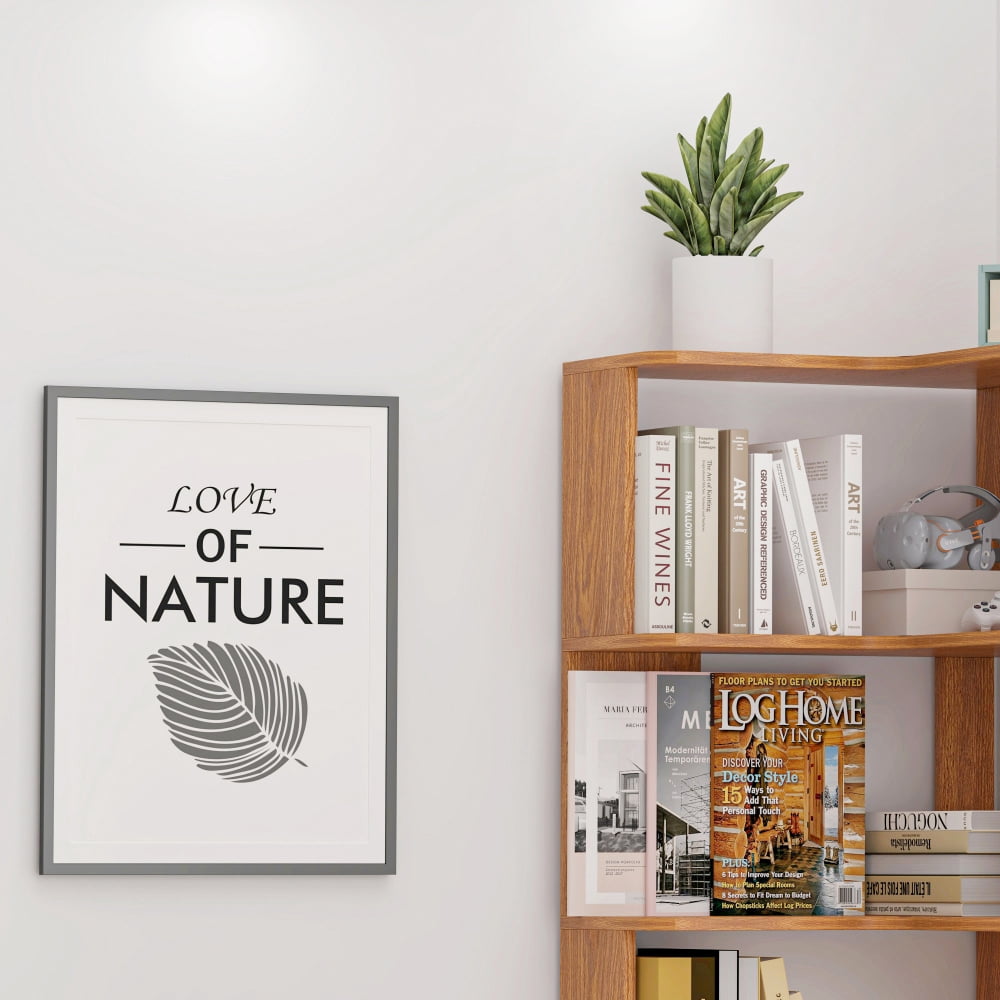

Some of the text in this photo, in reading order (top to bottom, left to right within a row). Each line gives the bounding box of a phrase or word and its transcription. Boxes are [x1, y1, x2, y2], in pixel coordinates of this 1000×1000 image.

[655, 463, 671, 515] FINE
[733, 477, 747, 510] ART
[847, 482, 861, 514] ART
[167, 483, 277, 515] LOVE
[760, 469, 768, 600] GRAPHIC DESIGN REFERENCED
[196, 528, 252, 563] OF
[789, 530, 807, 576] BORDEAUX
[654, 527, 671, 606] WINES
[810, 530, 828, 587] EERO SAARINEN
[104, 573, 345, 625] NATURE
[718, 676, 863, 687] FLOOR PLANS TO GET YOU STARTED
[761, 728, 823, 743] LIVING
[664, 746, 708, 754] Modernität
[722, 758, 783, 768] DISCOVER YOUR
[721, 770, 798, 786] Decor Style
[721, 786, 743, 804] 15
[744, 785, 775, 794] Ways to
[744, 796, 779, 804] Add That
[722, 806, 781, 815] Personal Touch
[884, 812, 948, 830] NOGUCHI
[890, 838, 932, 851] Remodelista
[747, 871, 770, 879] Improve
[784, 871, 804, 879] Design
